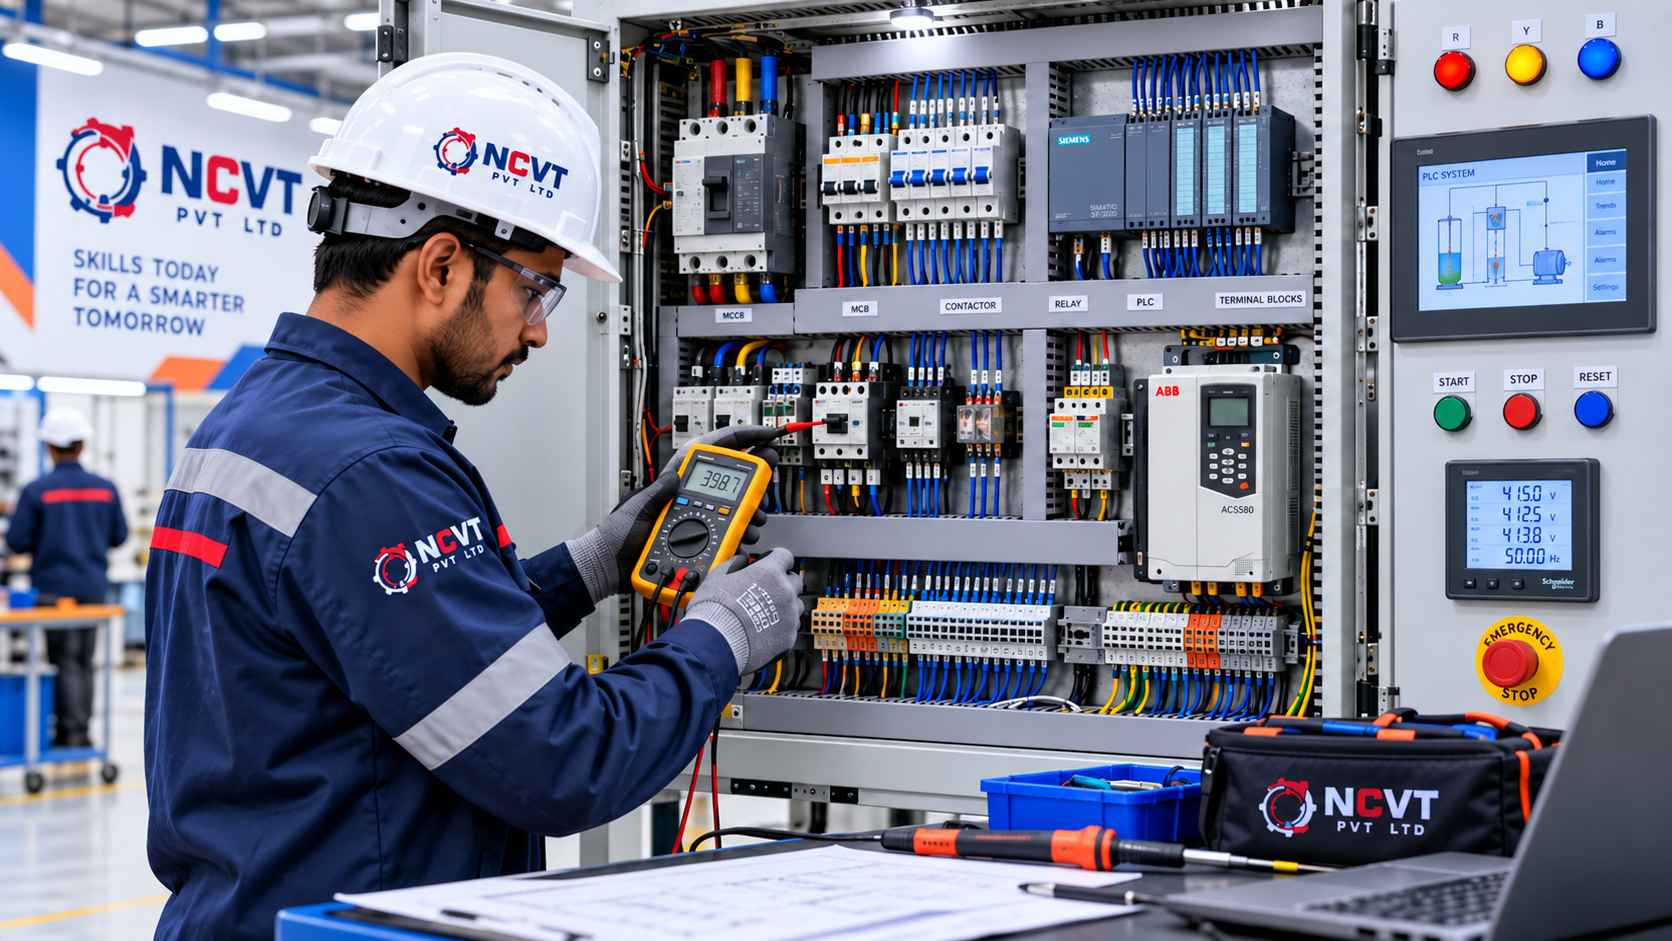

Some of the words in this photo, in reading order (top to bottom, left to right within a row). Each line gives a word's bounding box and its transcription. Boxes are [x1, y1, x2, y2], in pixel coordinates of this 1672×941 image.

[1596, 20, 1604, 29] B
[1523, 26, 1530, 35] Y
[1452, 33, 1459, 42] R
[482, 141, 569, 190] NCVT
[1596, 159, 1616, 167] Home
[161, 144, 302, 214] NCVT
[1422, 171, 1438, 181] PLC
[1441, 169, 1475, 180] SYSTEM
[492, 172, 519, 186] PVT
[530, 184, 553, 199] LTD
[1596, 178, 1615, 186] Home
[1595, 202, 1617, 210] Trends
[177, 207, 223, 228] PVT
[244, 217, 282, 237] LTD
[1594, 228, 1617, 236] Alarms
[73, 249, 143, 274] SKILLS
[153, 258, 219, 283] TODAY
[1592, 283, 1619, 292] Settings
[73, 278, 117, 300] FOR
[127, 283, 141, 302] A
[150, 286, 245, 313] SMARTER
[1219, 295, 1264, 305] TERMINAL
[1267, 294, 1303, 304] BLOCKS
[945, 301, 997, 311] CONTACTOR
[1054, 299, 1082, 308] RELAY
[1136, 297, 1155, 307] PLC
[73, 306, 205, 336] TOMORROW
[1438, 376, 1470, 387] START
[1510, 374, 1538, 385] STOP
[1579, 371, 1612, 382] RESET
[1155, 386, 1180, 397] ABB
[700, 470, 741, 493] 398.7
[1549, 491, 1556, 500] V
[1502, 505, 1542, 523] 412.5
[1549, 513, 1556, 521] V
[415, 517, 483, 563] NCVT
[1549, 534, 1556, 543] V
[432, 556, 456, 572] PVT
[464, 545, 484, 559] LTD
[1505, 547, 1546, 565] 50.00
[1549, 554, 1561, 563] Hz
[1483, 621, 1556, 650] EMERGENCY
[1501, 687, 1538, 701] STOP
[1325, 787, 1439, 820] NCVT
[1337, 821, 1373, 833] PVT
[1390, 823, 1425, 836] LTD
